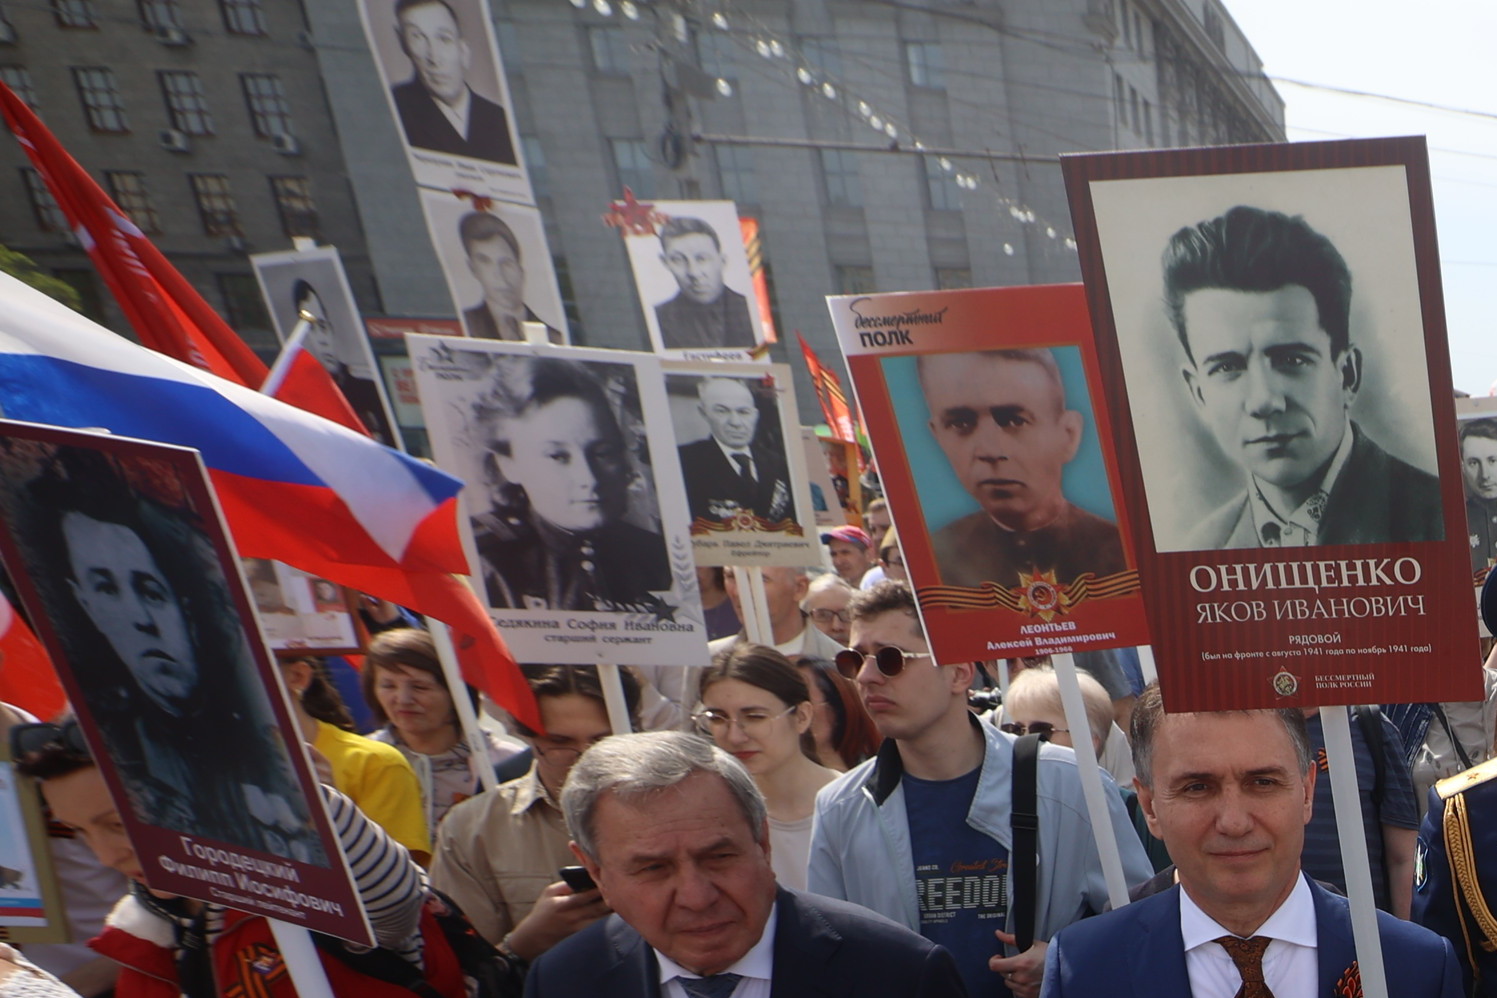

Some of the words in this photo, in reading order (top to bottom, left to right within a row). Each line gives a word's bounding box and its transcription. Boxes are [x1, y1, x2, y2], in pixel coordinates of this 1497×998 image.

[859, 330, 914, 347] ПОЛК
[1189, 557, 1422, 594] ОНИЩЕНКО
[1196, 600, 1267, 624] ЯКОВ
[1272, 594, 1427, 621] ИВАНОВИЧ
[493, 616, 560, 630] Седякина
[567, 618, 617, 632] София
[624, 620, 695, 633] Ивановна
[1020, 621, 1077, 635] ЛЕОНТЬЕВ
[544, 633, 597, 644] старший
[602, 635, 653, 645] сержант
[987, 638, 1033, 651] Алексей
[1034, 631, 1116, 646] Владимирович
[1288, 632, 1342, 645] РЯДОВОЙ
[1201, 651, 1221, 661] (был
[1222, 652, 1233, 660] на
[1234, 650, 1264, 661] фронте
[1271, 649, 1302, 659] августа
[1303, 647, 1323, 656] 1941
[1325, 647, 1344, 656] года
[1357, 645, 1387, 656] ноябрь
[1388, 644, 1408, 654] 1941
[1410, 643, 1432, 654] года)
[1315, 672, 1375, 682] БЕССМЕРТНЫЙ
[1315, 681, 1339, 689] ПОЛК
[1339, 680, 1372, 688] РОССИИ
[179, 835, 301, 883] Городецкий
[158, 854, 236, 888] Филипп
[233, 871, 345, 917] Иосифович
[916, 874, 1007, 911] REEDO
